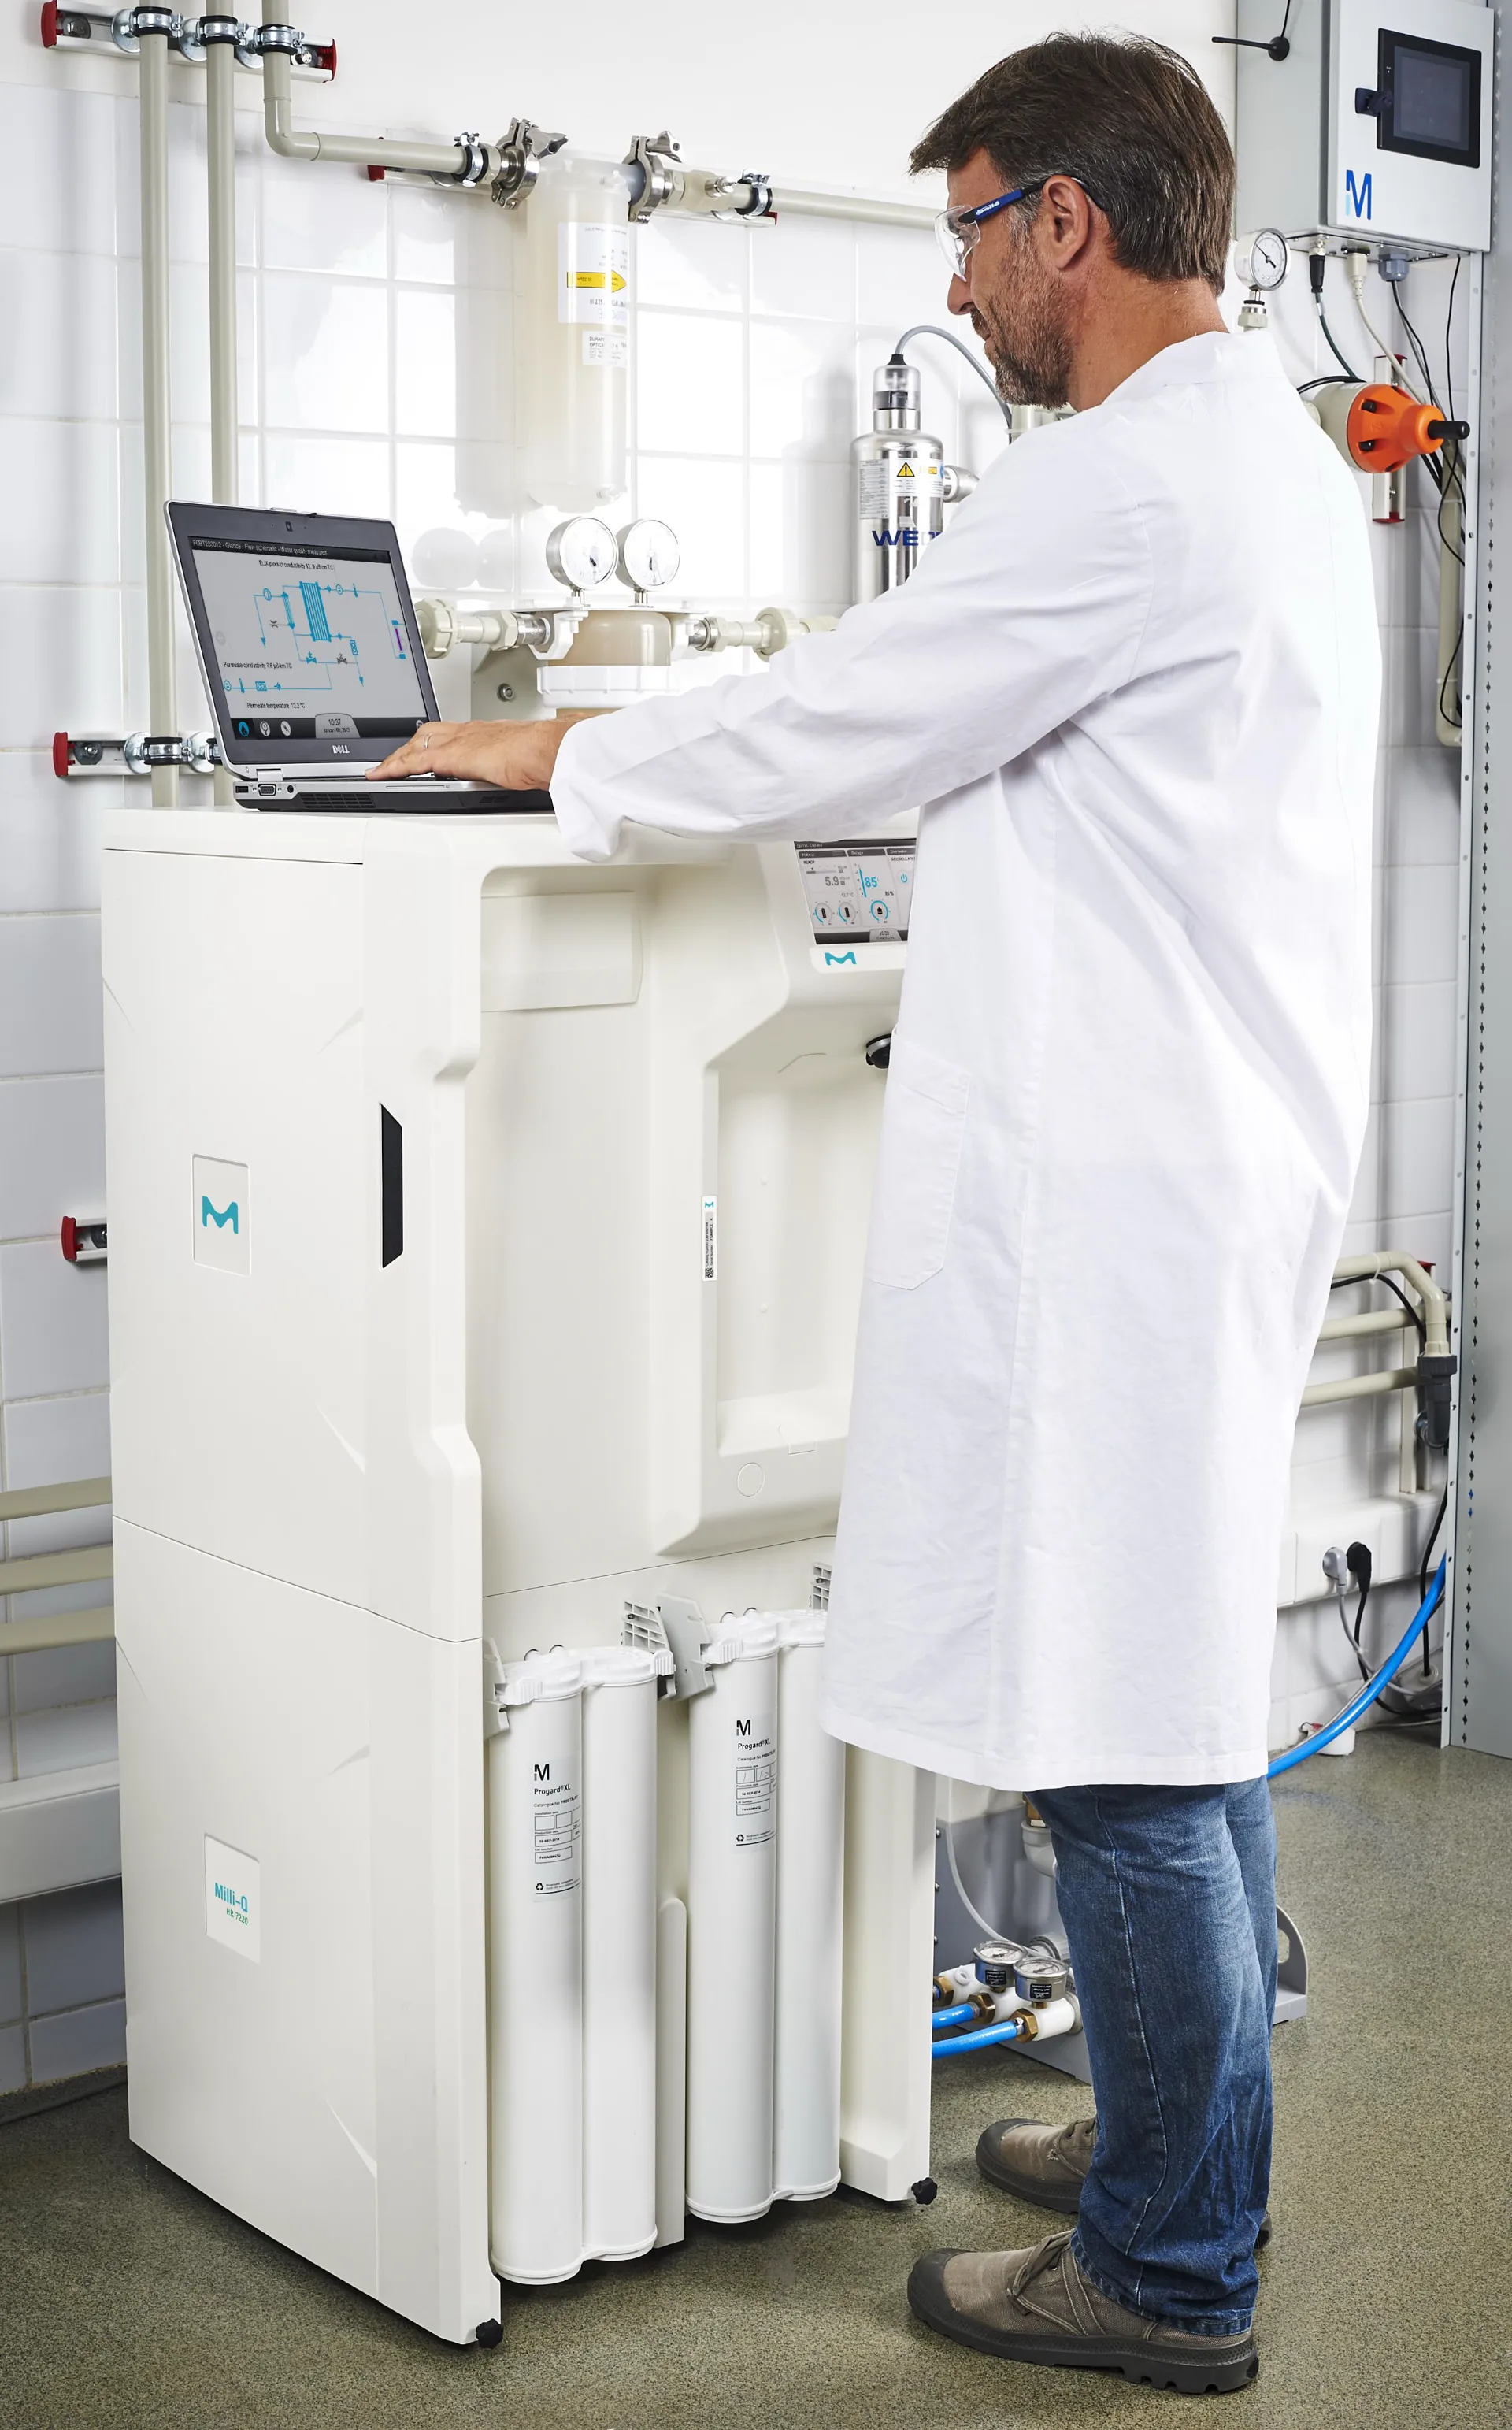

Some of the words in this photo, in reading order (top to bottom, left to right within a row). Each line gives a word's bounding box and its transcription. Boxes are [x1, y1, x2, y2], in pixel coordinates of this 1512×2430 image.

[332, 744, 350, 754] DELL
[825, 876, 839, 886] 5.9
[865, 877, 877, 888] 85
[215, 1882, 248, 1913] Milli-Q
